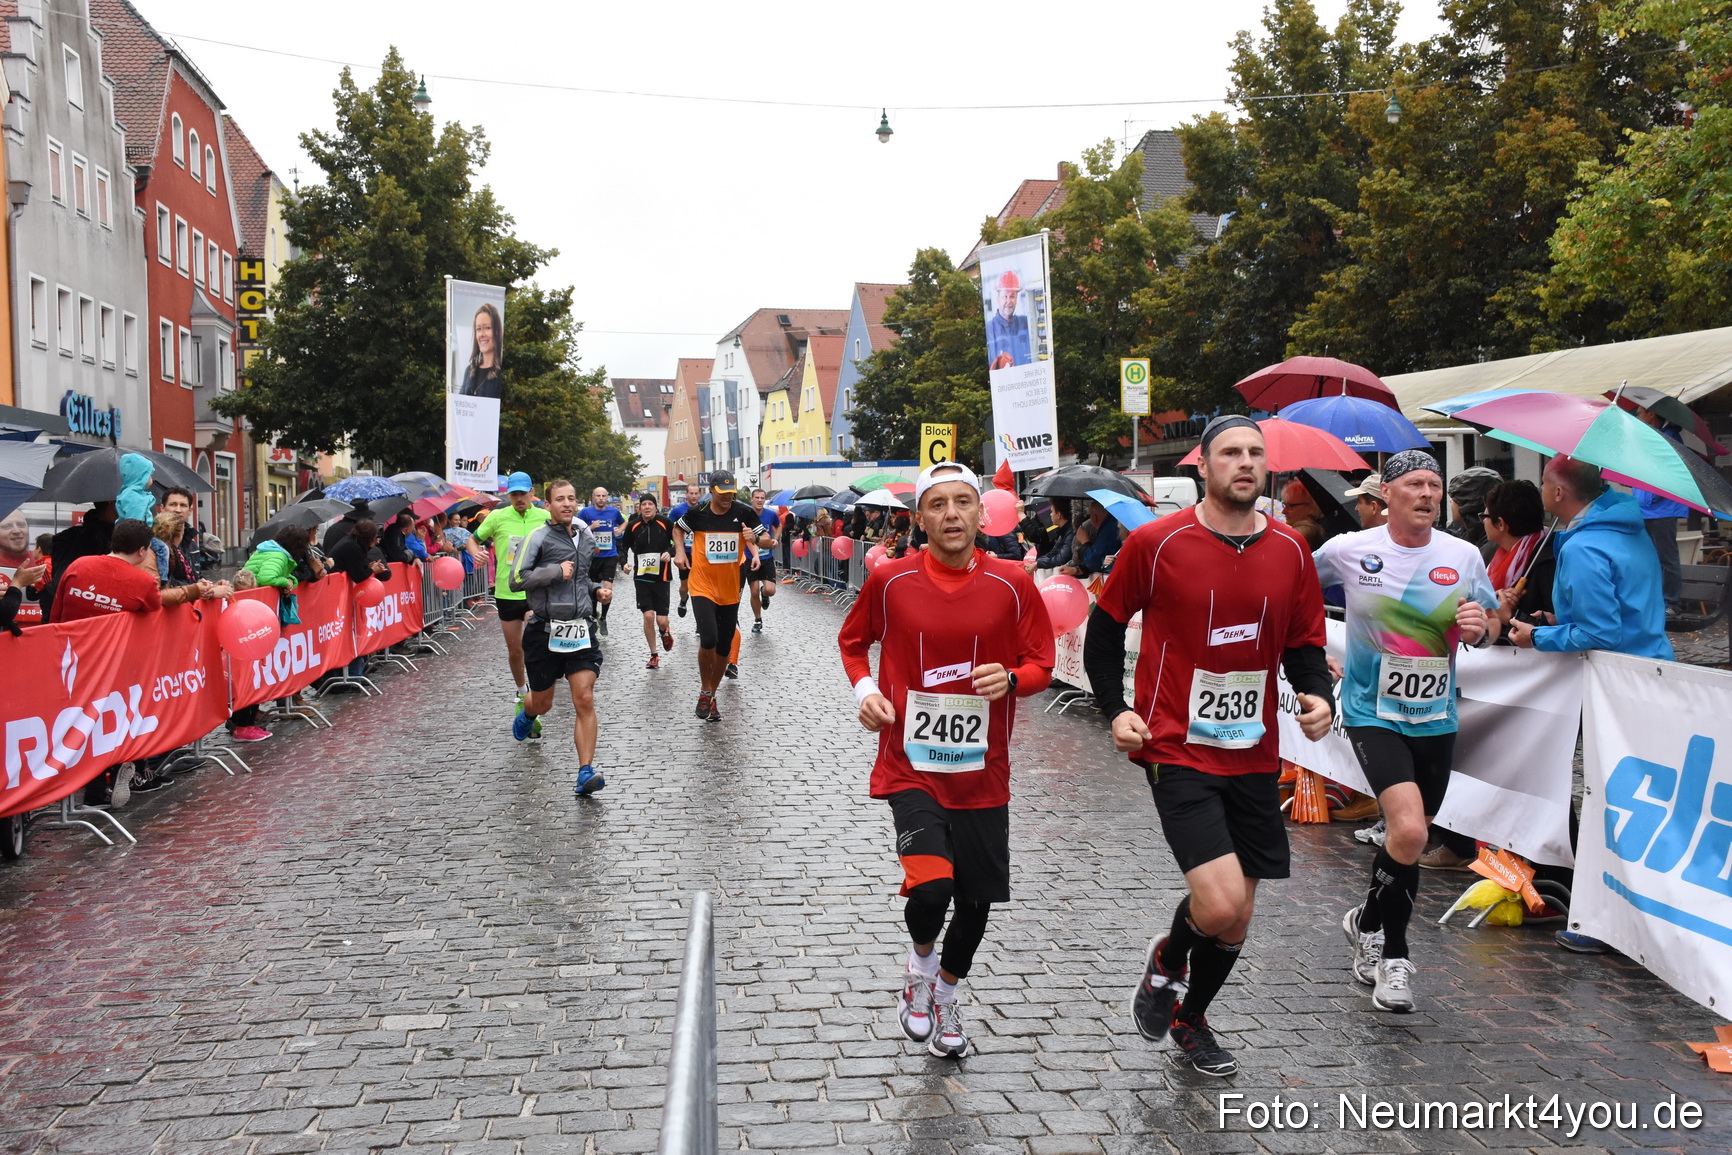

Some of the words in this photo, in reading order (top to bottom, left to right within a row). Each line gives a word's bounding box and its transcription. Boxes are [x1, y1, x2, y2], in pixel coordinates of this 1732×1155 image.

[1130, 367, 1141, 379] H
[65, 390, 112, 437] Eilles
[925, 425, 952, 436] Block
[928, 439, 947, 465] C
[595, 535, 611, 543] 2139
[709, 540, 736, 552] 2810
[642, 558, 656, 567] 262
[1359, 575, 1383, 583] PARTL
[94, 602, 121, 611] energie
[555, 625, 586, 639] 2776
[1223, 629, 1245, 639] DEHN
[936, 668, 958, 680] DEHN
[1227, 674, 1262, 685] BOCK
[1387, 671, 1448, 699] 2028
[944, 697, 984, 709] BOCK
[1198, 690, 1258, 721] 2538
[1397, 702, 1433, 715] Thomas
[914, 711, 982, 743] 2462
[1213, 727, 1245, 740] Jürgen
[929, 749, 964, 762] Daniel
